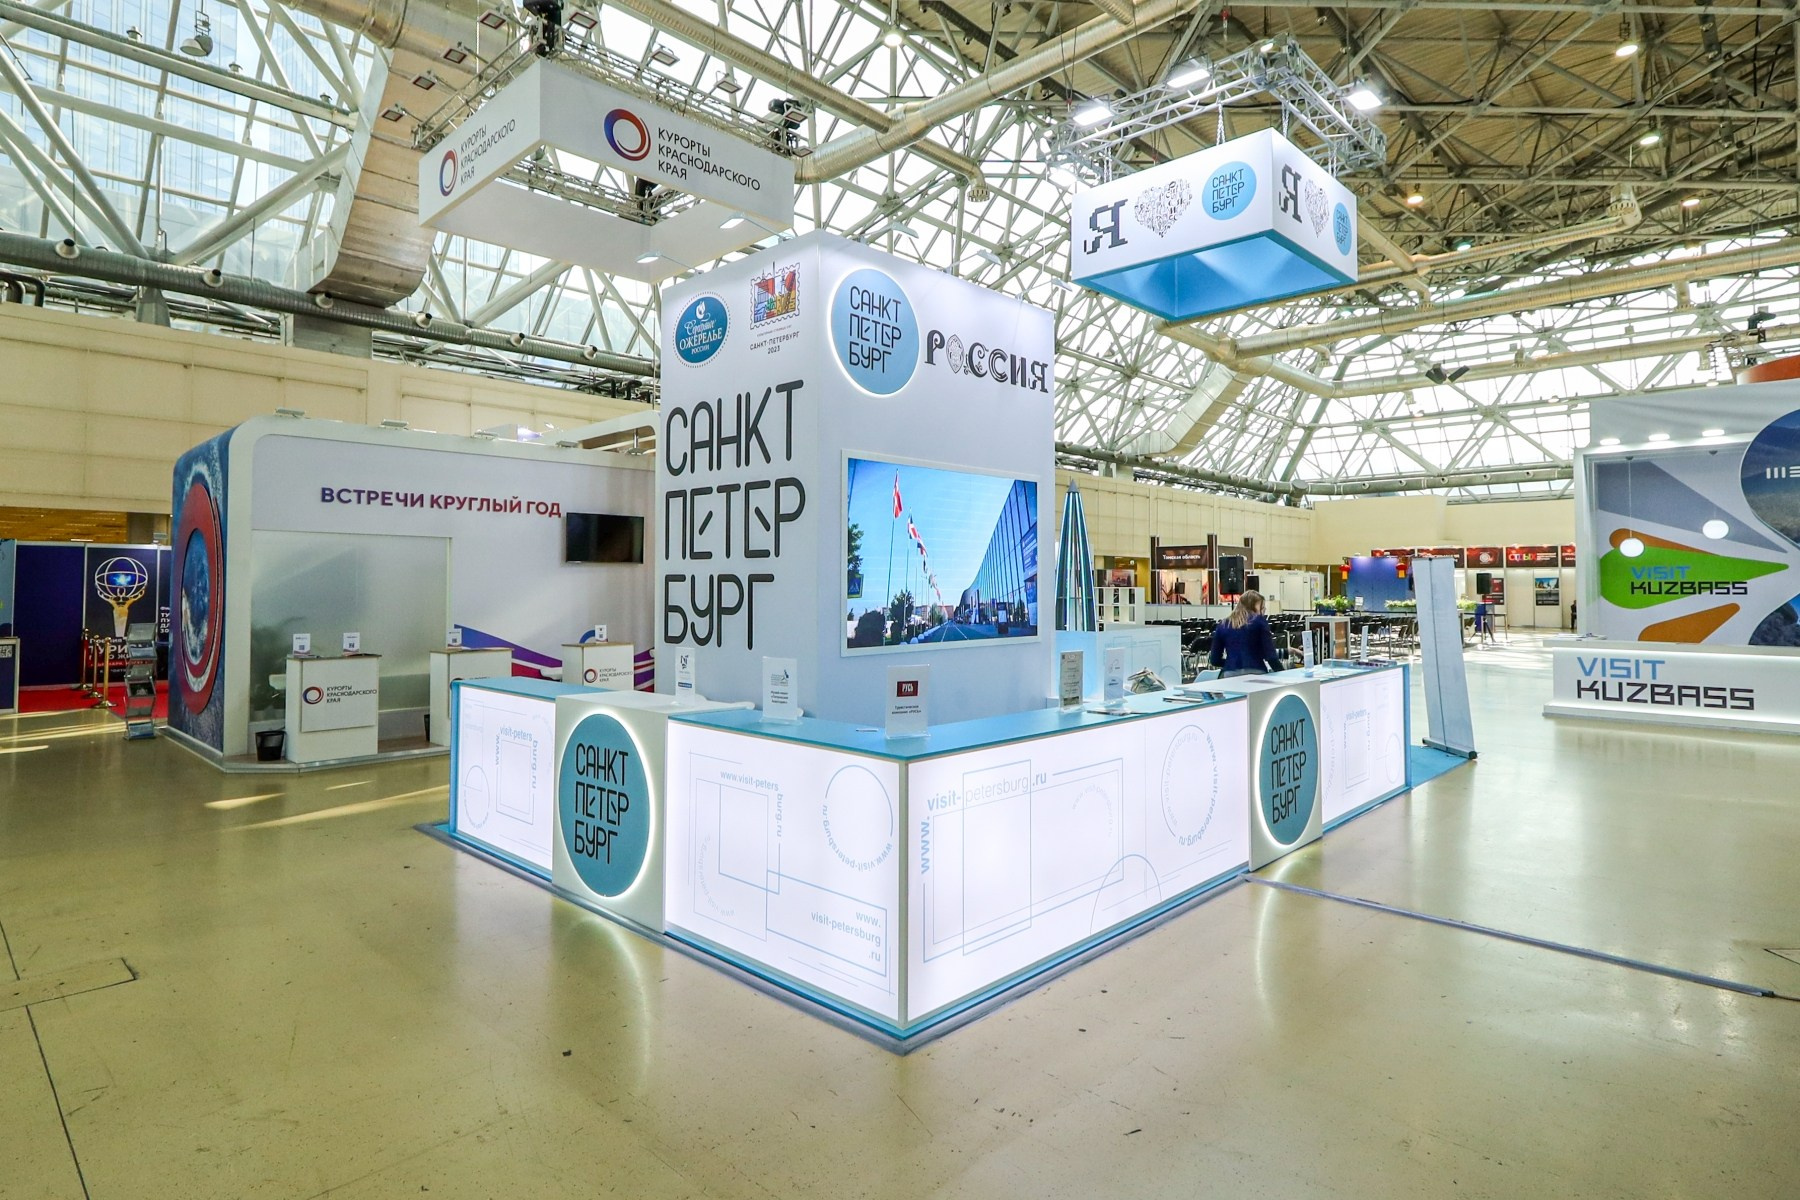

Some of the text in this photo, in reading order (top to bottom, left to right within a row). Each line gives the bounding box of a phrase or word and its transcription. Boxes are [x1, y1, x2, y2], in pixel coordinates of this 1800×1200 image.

[461, 124, 487, 155] КУРОРТЫ
[461, 119, 516, 170] КРАСНОДАРСКОГО
[658, 127, 711, 158] КУРОРТЫ
[461, 166, 475, 186] КРАЯ
[658, 143, 761, 191] КРАСНОДАРСКОГО
[658, 160, 688, 181] КРАЯ
[1212, 168, 1245, 188] САНКТ
[1212, 181, 1245, 201] ПЕТЕР
[1212, 195, 1239, 214] БУРГ
[850, 285, 902, 323] САНКТ
[680, 328, 723, 351] ОЖЕРЕЛЬЕ
[850, 313, 902, 349] ПЕТЕР
[768, 346, 780, 355] 2023
[849, 341, 892, 374] БУРГ
[666, 380, 804, 476] САНКТ
[320, 487, 562, 518] ВСТРЕЧИ КРУГЛЫЙ ГОД
[665, 477, 806, 560] ПЕТЕР
[1631, 566, 1691, 580] VISIT
[1631, 581, 1748, 595] KUZBASS
[664, 573, 775, 651] БУРГ
[1577, 656, 1666, 680] VISIT
[326, 689, 377, 698] КРАСНОДАРСКОГО
[1577, 680, 1755, 711] KUZBASS
[500, 725, 533, 742] visit-peters
[1271, 718, 1305, 755] САНКТ
[576, 743, 629, 786] САНКТ
[1271, 751, 1307, 790] ПЕТЕР
[720, 771, 779, 792] www.visit-peters
[576, 781, 629, 826] ПЕТЕР
[775, 793, 783, 838] burg.ru
[1272, 785, 1300, 824] БУРГ
[575, 820, 618, 864] БУРГ
[822, 805, 893, 873] www.visit-petersburg.ru
[921, 816, 930, 875] www.
[811, 911, 881, 948] visit-petersburg
[855, 911, 881, 929] www.
[868, 949, 881, 962] .ru
